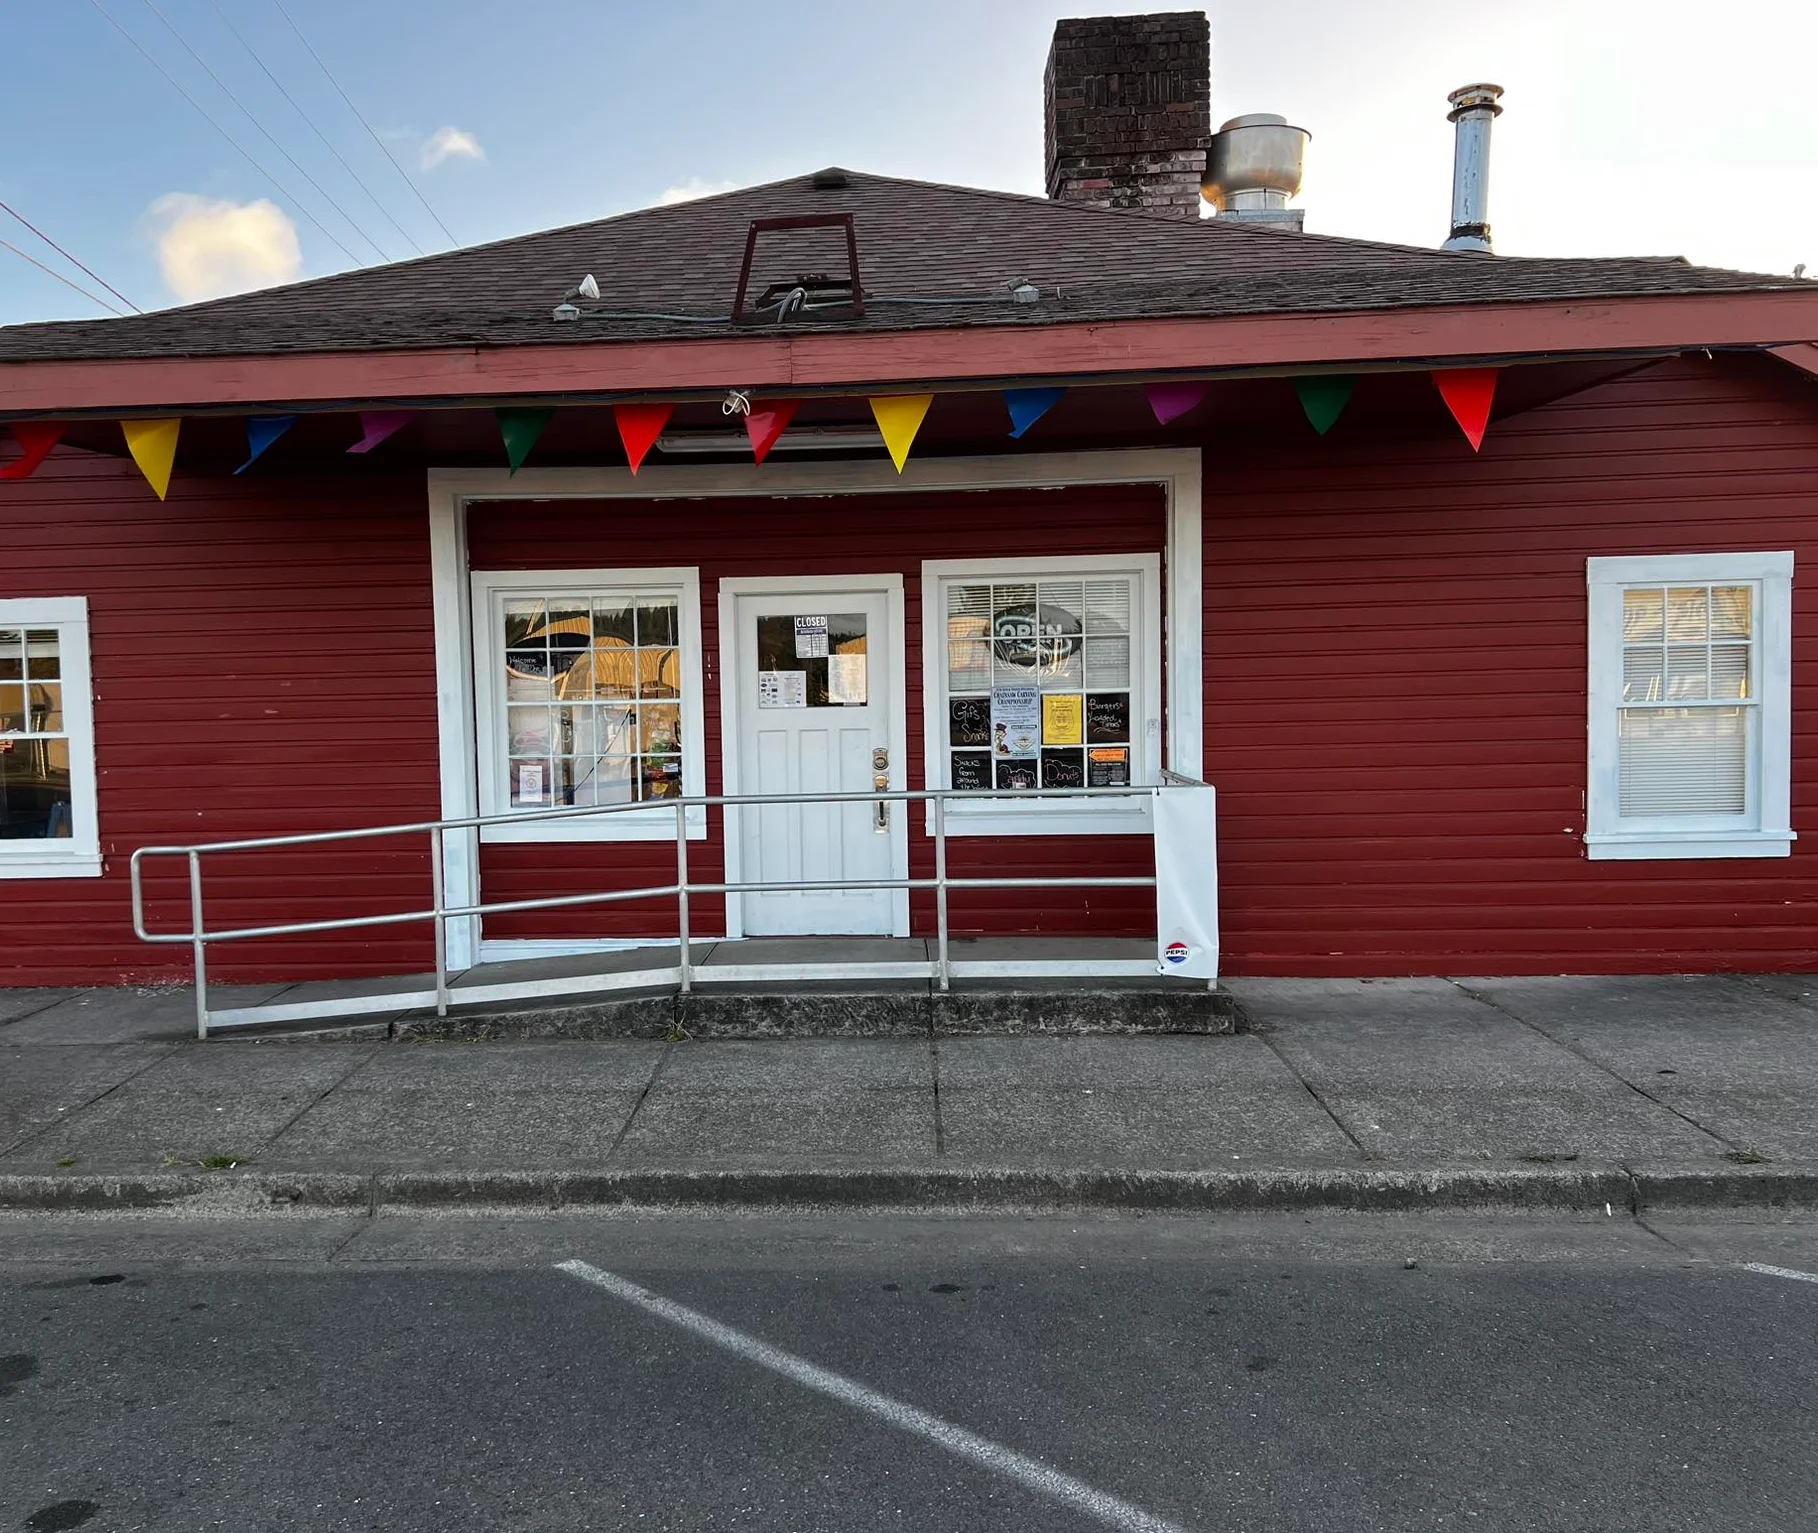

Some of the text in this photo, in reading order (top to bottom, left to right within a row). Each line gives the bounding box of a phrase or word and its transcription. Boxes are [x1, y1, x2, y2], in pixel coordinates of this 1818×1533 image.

[796, 616, 826, 628] CLOSED
[1000, 624, 1062, 644] OPEN
[1017, 690, 1037, 698] CARVING
